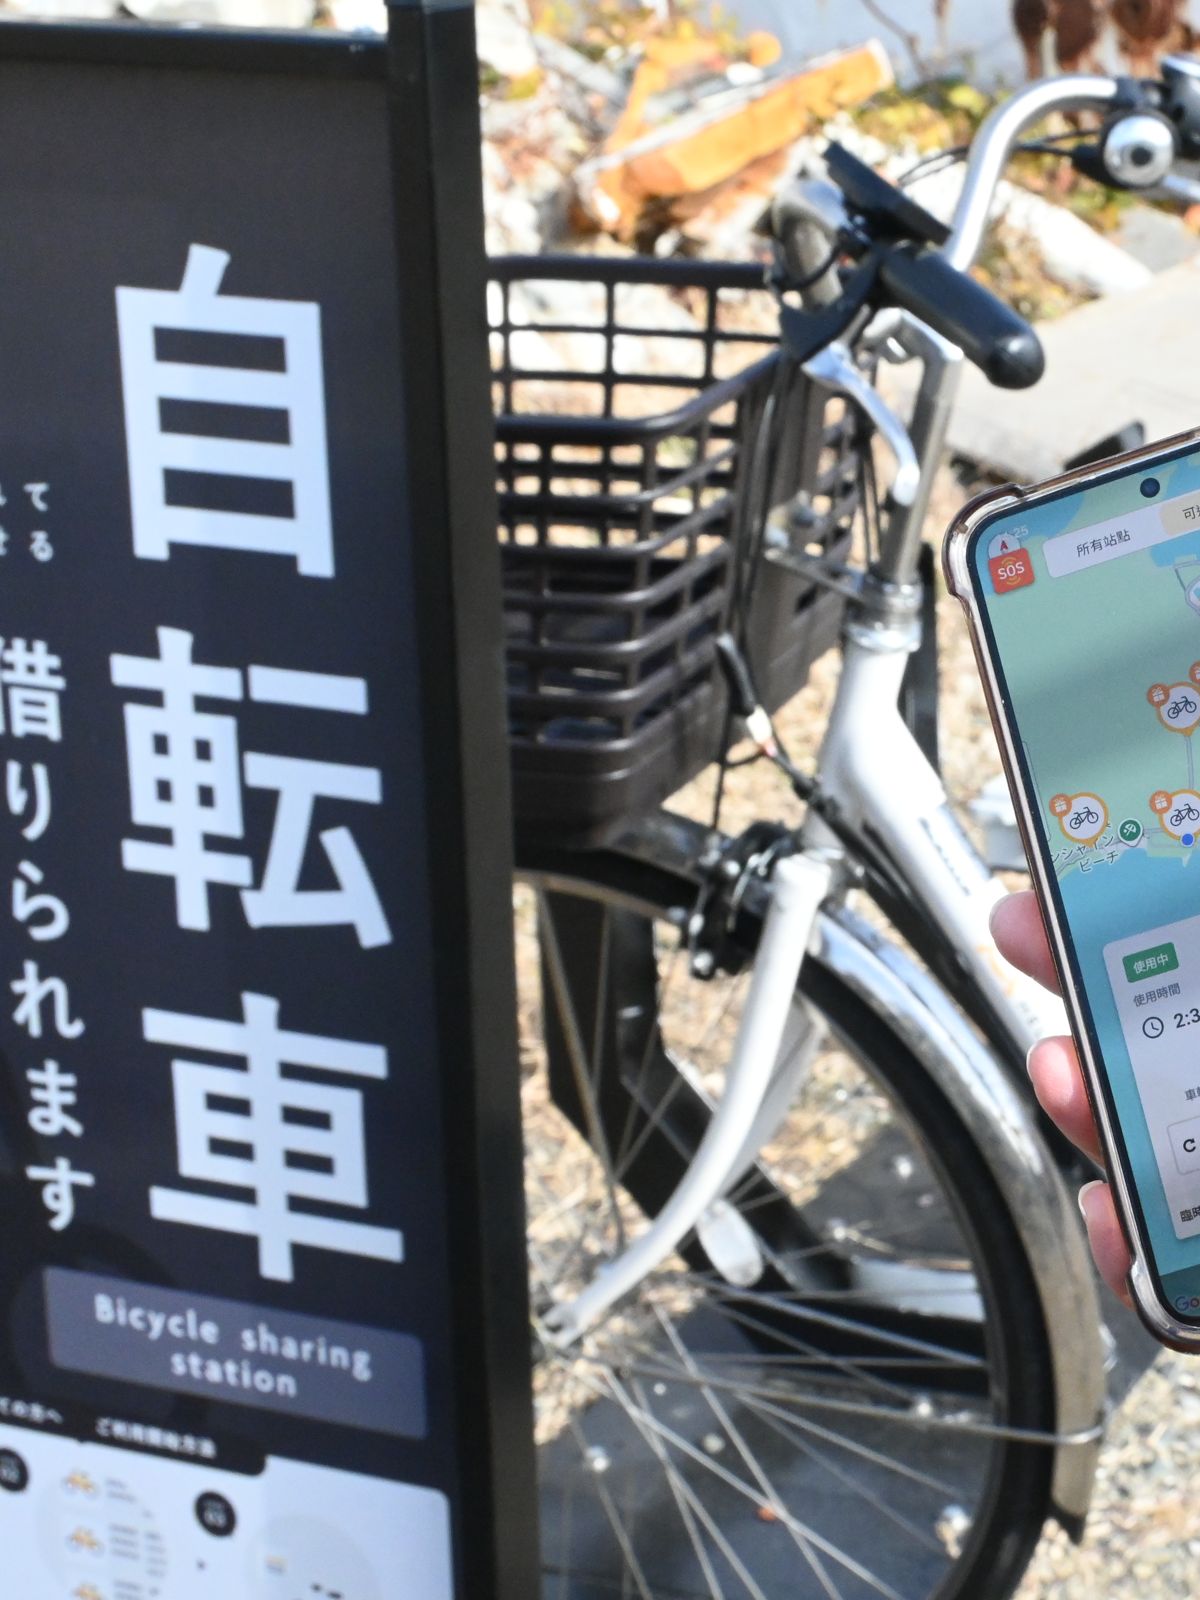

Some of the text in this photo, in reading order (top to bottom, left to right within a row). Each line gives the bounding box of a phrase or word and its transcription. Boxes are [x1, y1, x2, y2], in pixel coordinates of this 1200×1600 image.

[1076, 528, 1131, 558] 所有站點
[997, 561, 1025, 581] SOS
[110, 243, 404, 1282] 自転車
[1079, 850, 1119, 872] ビーチ
[0, 635, 95, 1232] 借りられます
[1132, 953, 1169, 975] 使用中
[1133, 982, 1181, 1007] 使用時間
[95, 1293, 373, 1383] Bicycle sharing
[170, 1351, 297, 1398] station
